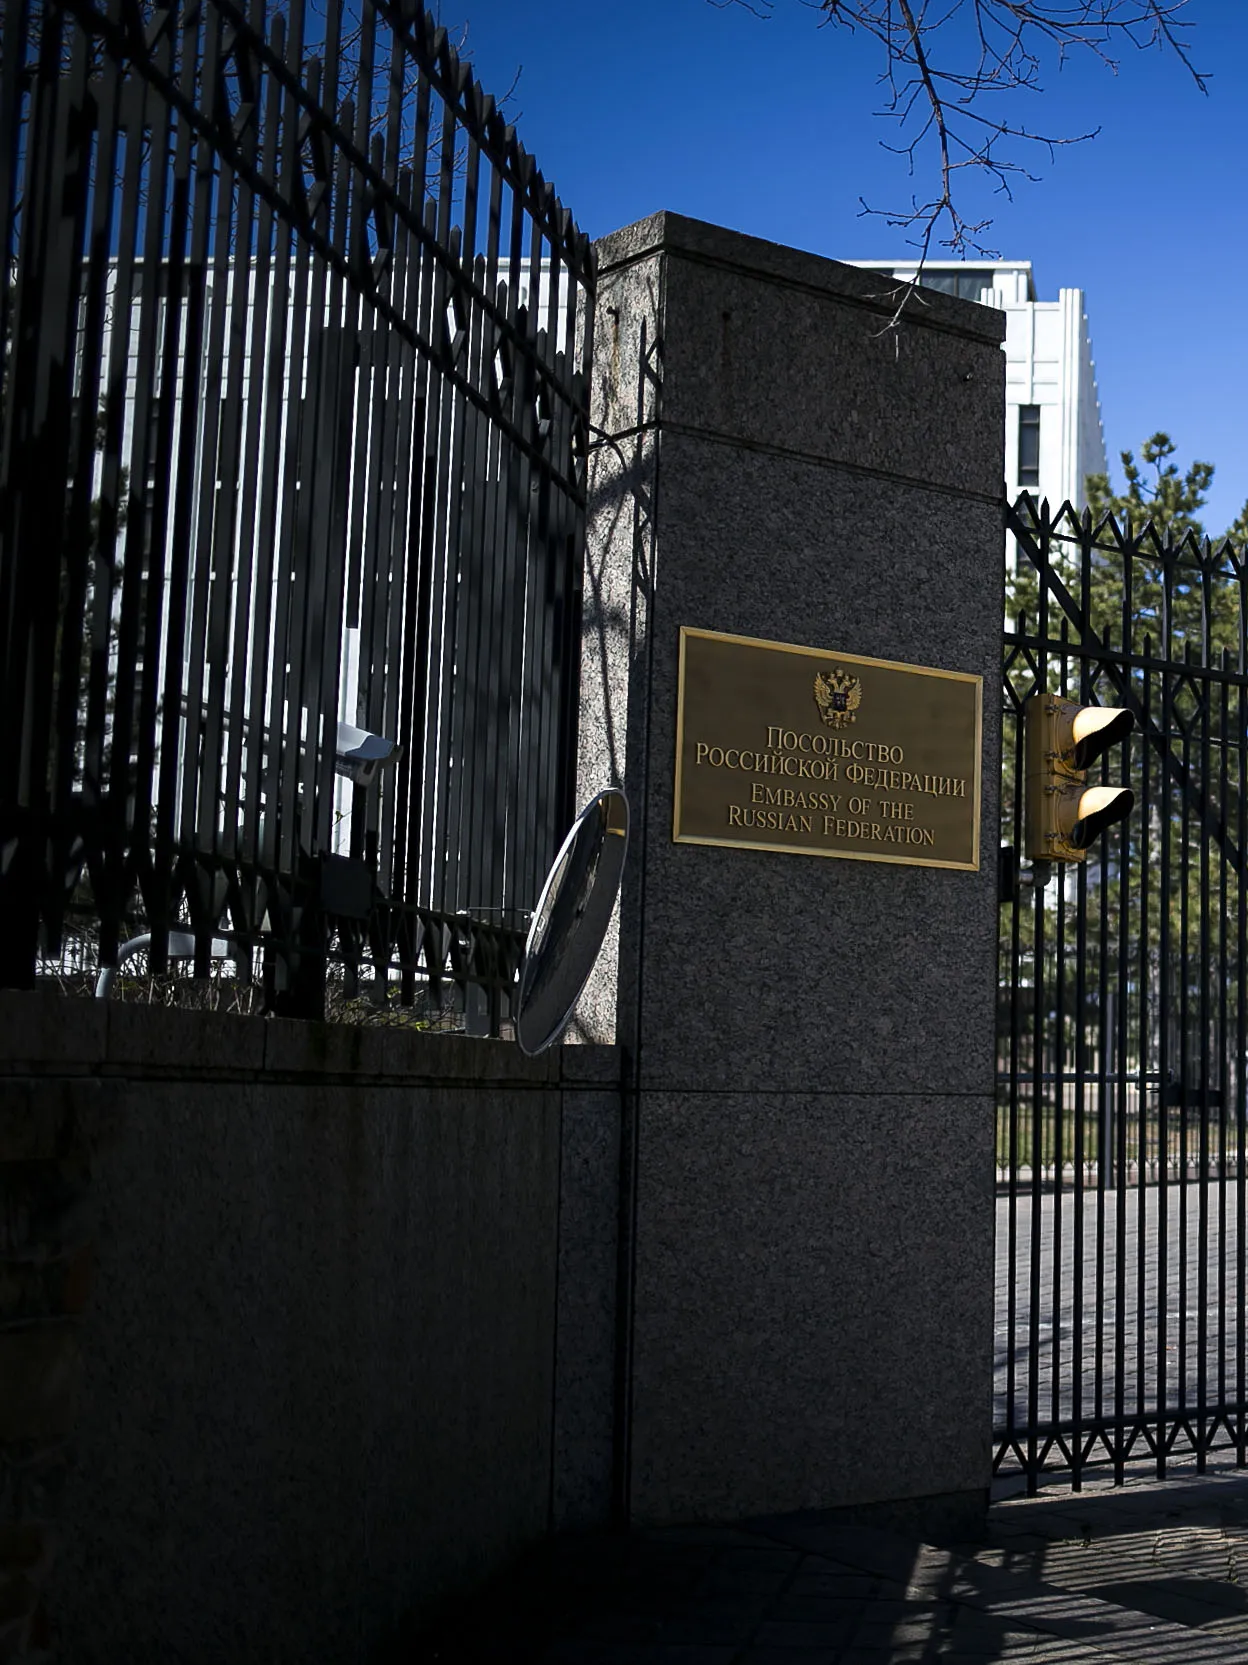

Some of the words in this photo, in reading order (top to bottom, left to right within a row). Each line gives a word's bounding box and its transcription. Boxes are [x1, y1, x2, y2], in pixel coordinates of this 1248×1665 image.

[767, 726, 904, 764] ПОСОЛЬСТВО
[696, 742, 838, 781] РОССИЙСКОЙ
[846, 762, 966, 798] ФЕДЕРАЦИИ
[751, 783, 842, 811] EMBASSY
[849, 796, 871, 816] OF
[880, 800, 915, 820] THE
[728, 805, 812, 833] RUSSIAN
[824, 815, 935, 846] FEDERATION
